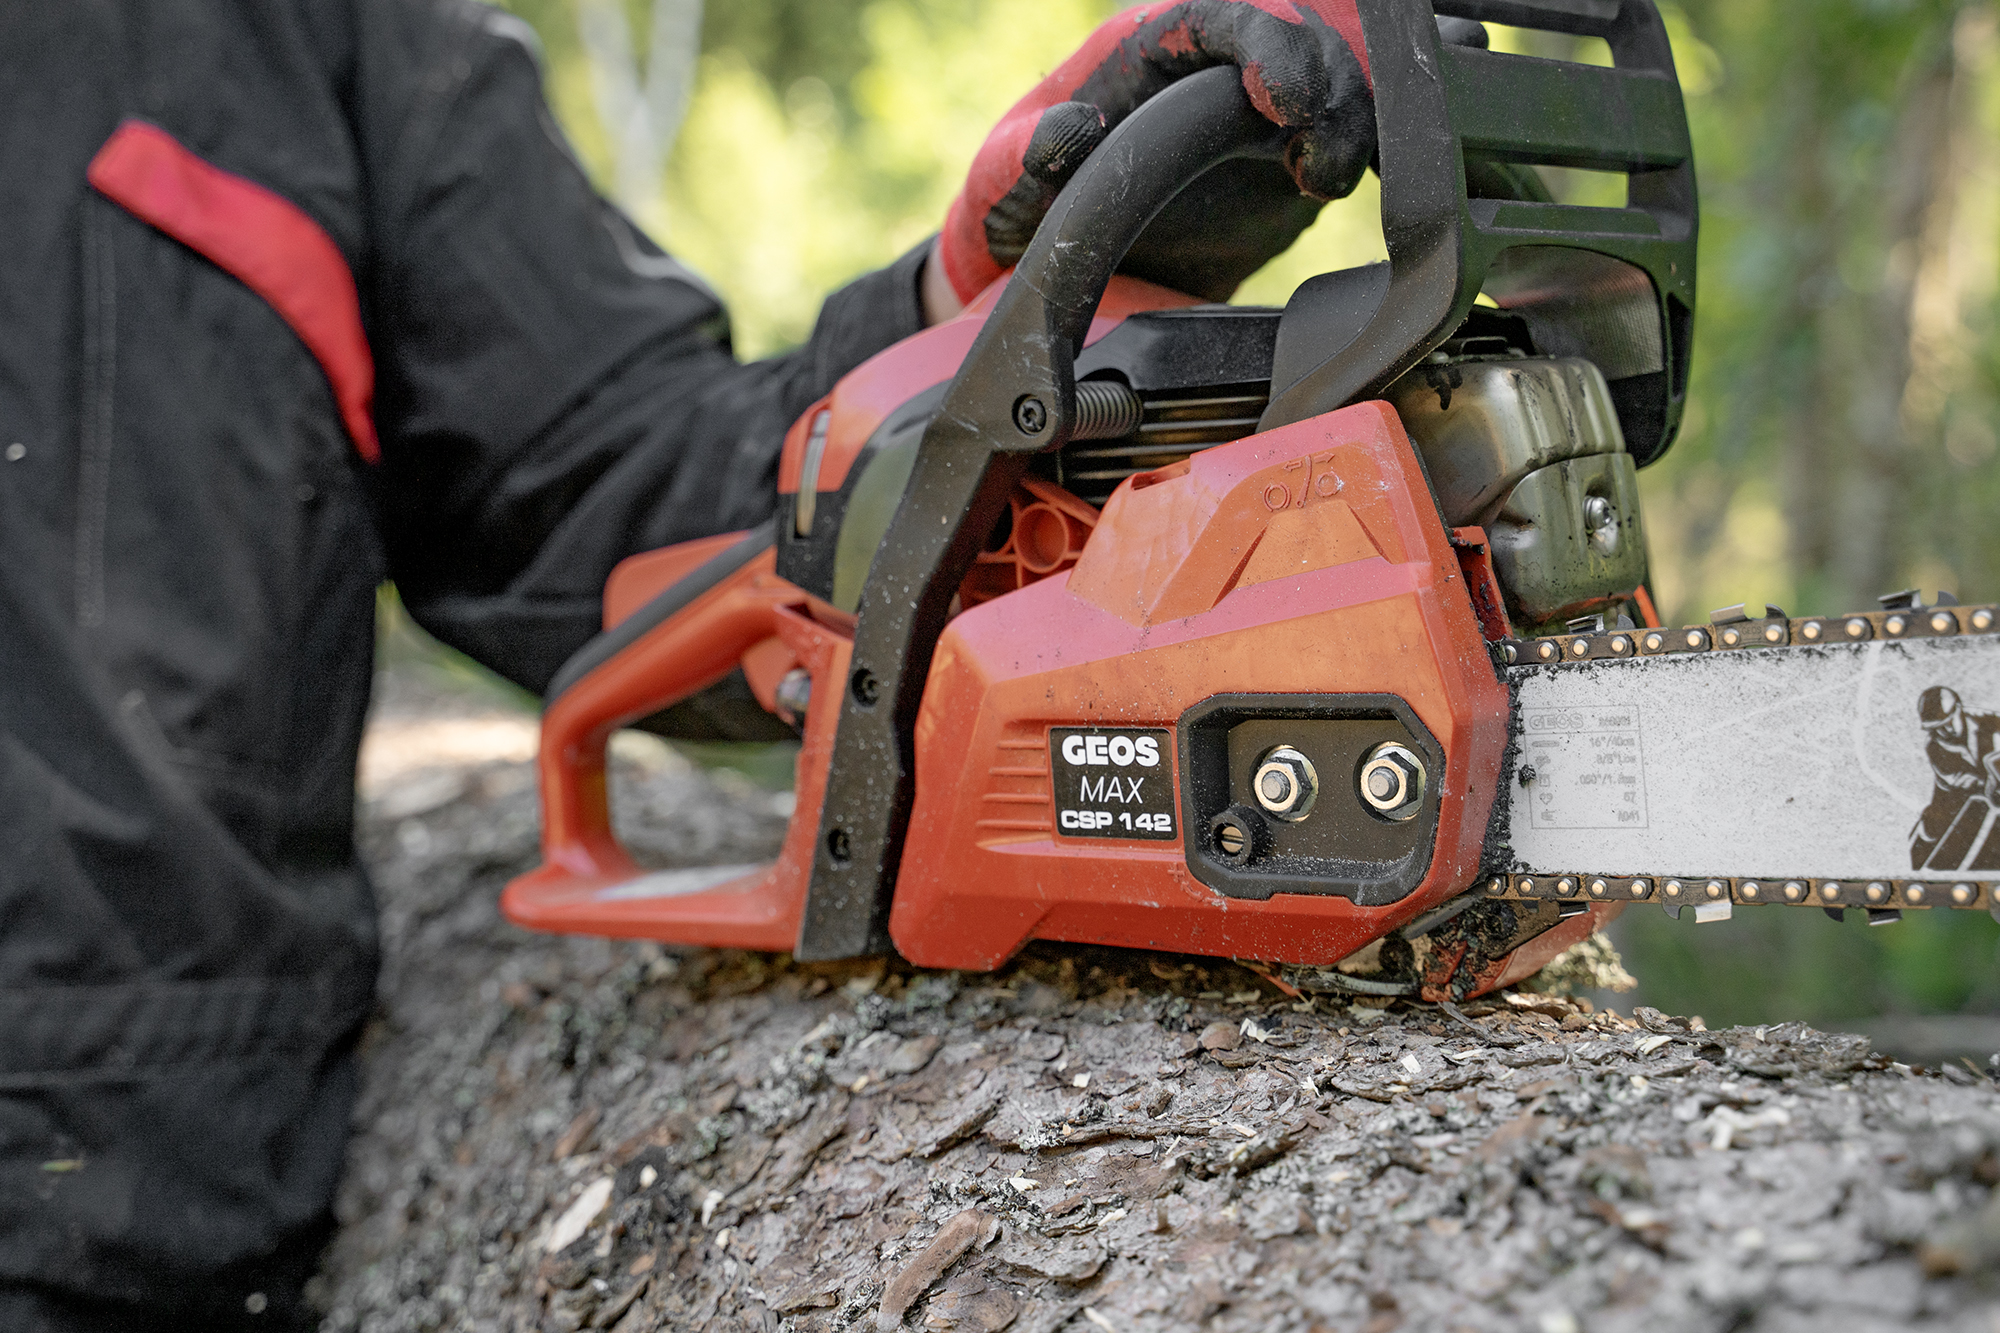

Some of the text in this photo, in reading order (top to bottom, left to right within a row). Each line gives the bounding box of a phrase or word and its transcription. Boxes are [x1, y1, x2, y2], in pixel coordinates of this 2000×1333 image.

[1529, 713, 1583, 730] GEOS
[1061, 735, 1160, 767] GEOS
[1080, 775, 1144, 804] MAX
[1061, 810, 1172, 832] CSP 142
